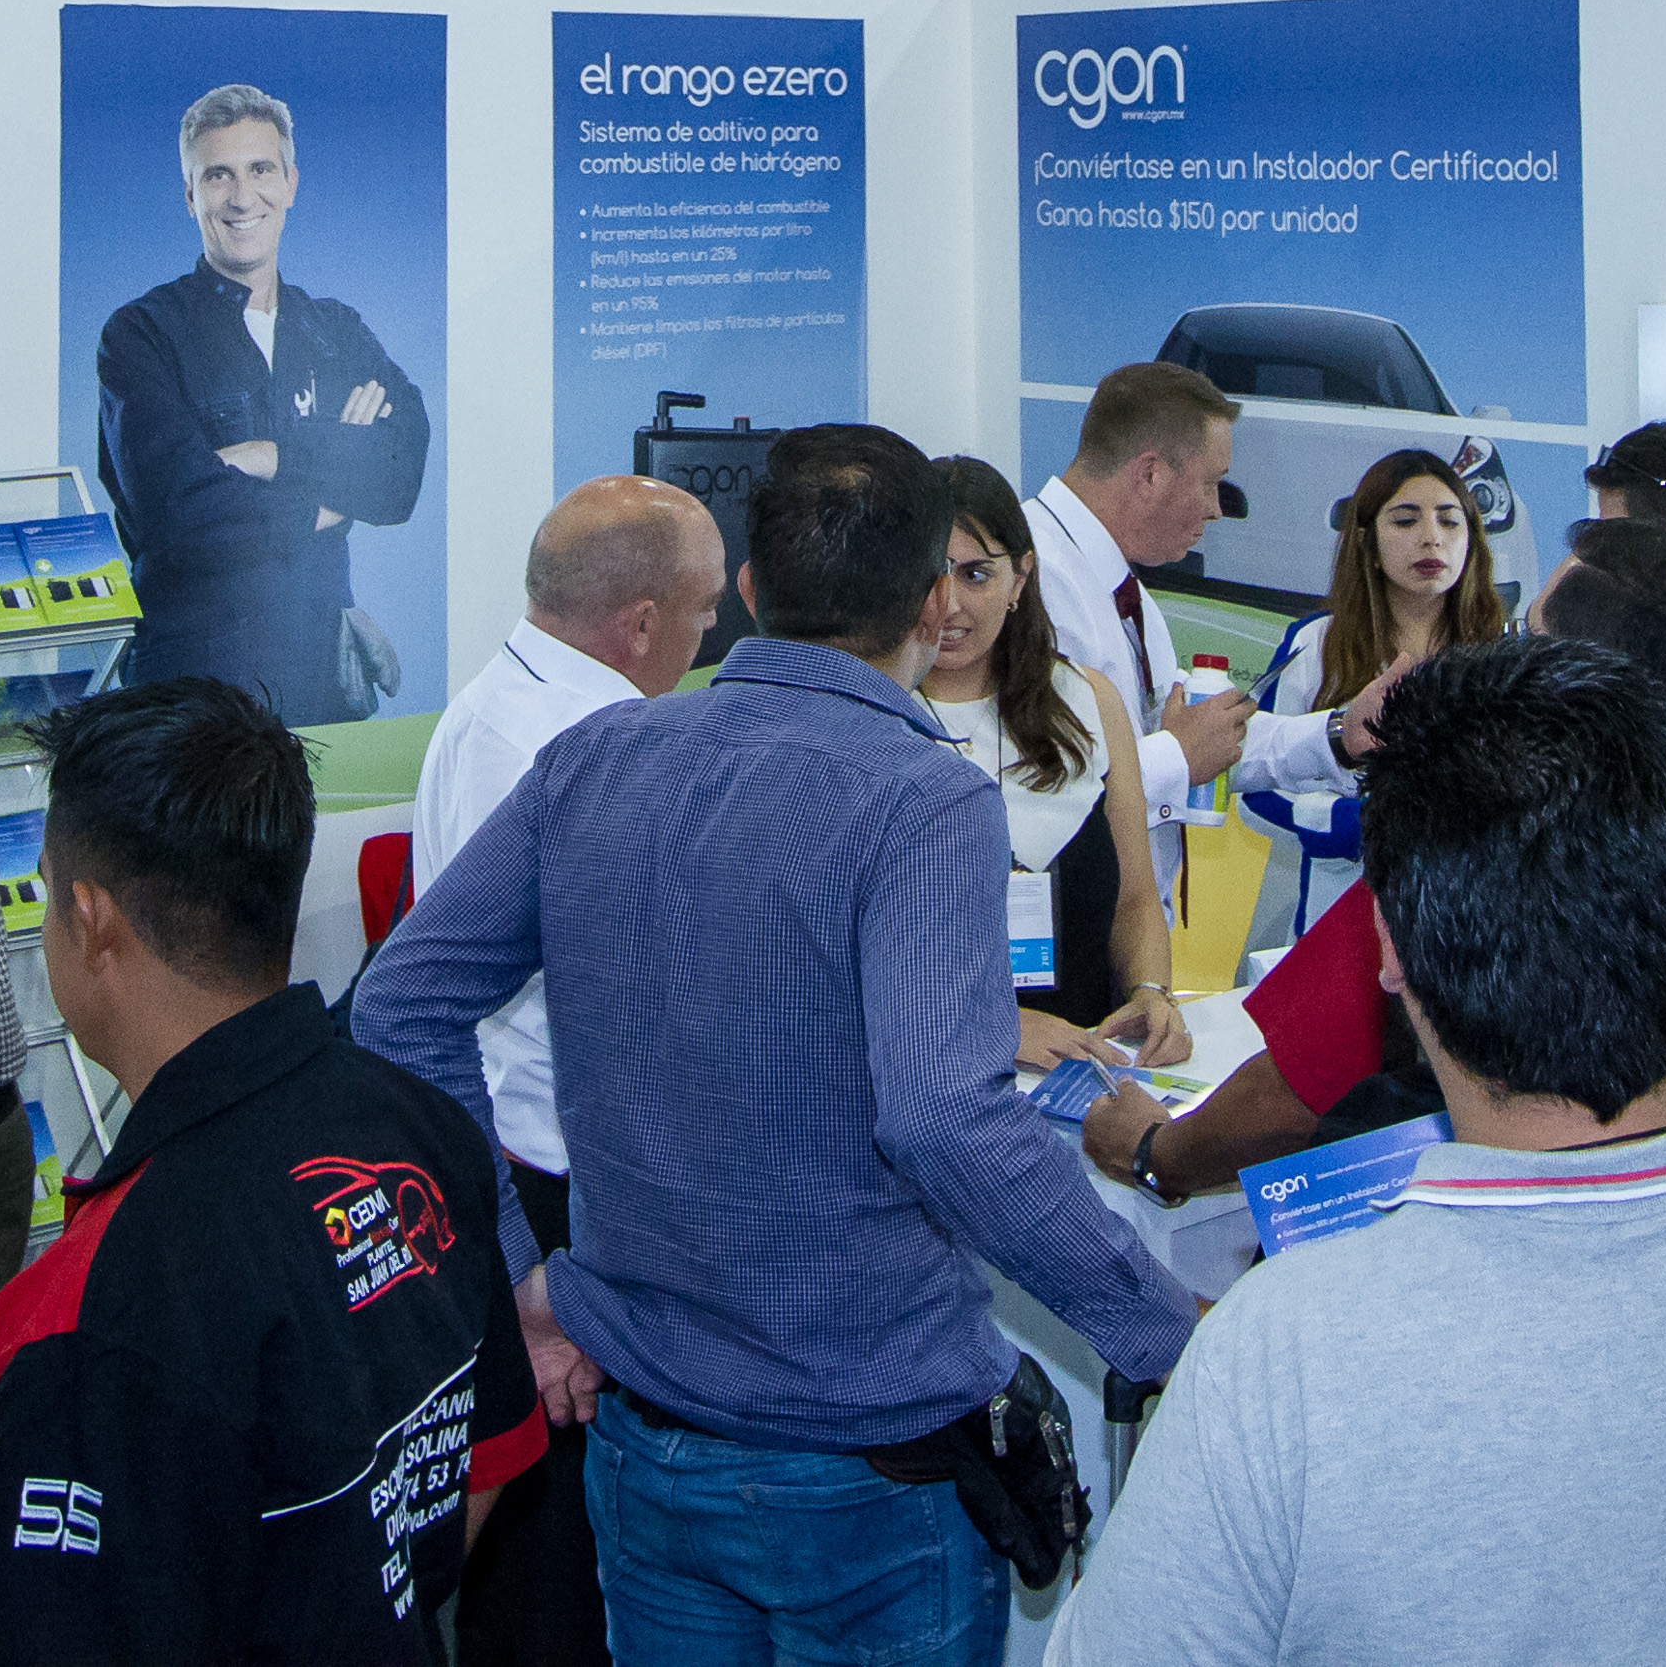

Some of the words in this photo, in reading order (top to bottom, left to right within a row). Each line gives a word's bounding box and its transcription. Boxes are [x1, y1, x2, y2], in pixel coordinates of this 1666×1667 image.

[580, 51, 614, 95] el
[622, 64, 736, 108] rango
[743, 65, 849, 98] ezero
[1034, 44, 1186, 130] cgon
[579, 120, 662, 143] Sistema
[666, 120, 694, 142] de
[698, 120, 767, 142] aditivo
[771, 124, 819, 147] para
[579, 152, 706, 174] combustible
[710, 151, 737, 173] de
[741, 150, 842, 177] hidrógeno
[1034, 150, 1175, 187] ¡Conviértase
[1180, 156, 1212, 181] en
[1215, 156, 1248, 181] un
[1252, 149, 1384, 182] Instalador
[1389, 149, 1559, 183] Certificado!
[1036, 198, 1093, 229] Gana
[1099, 198, 1163, 230] hasta
[1168, 198, 1215, 231] $150
[1220, 210, 1265, 238] por
[1271, 203, 1359, 234] unidad
[1260, 1174, 1309, 1202] cgon
[347, 1273, 370, 1304] SAN
[427, 1460, 450, 1493] 53
